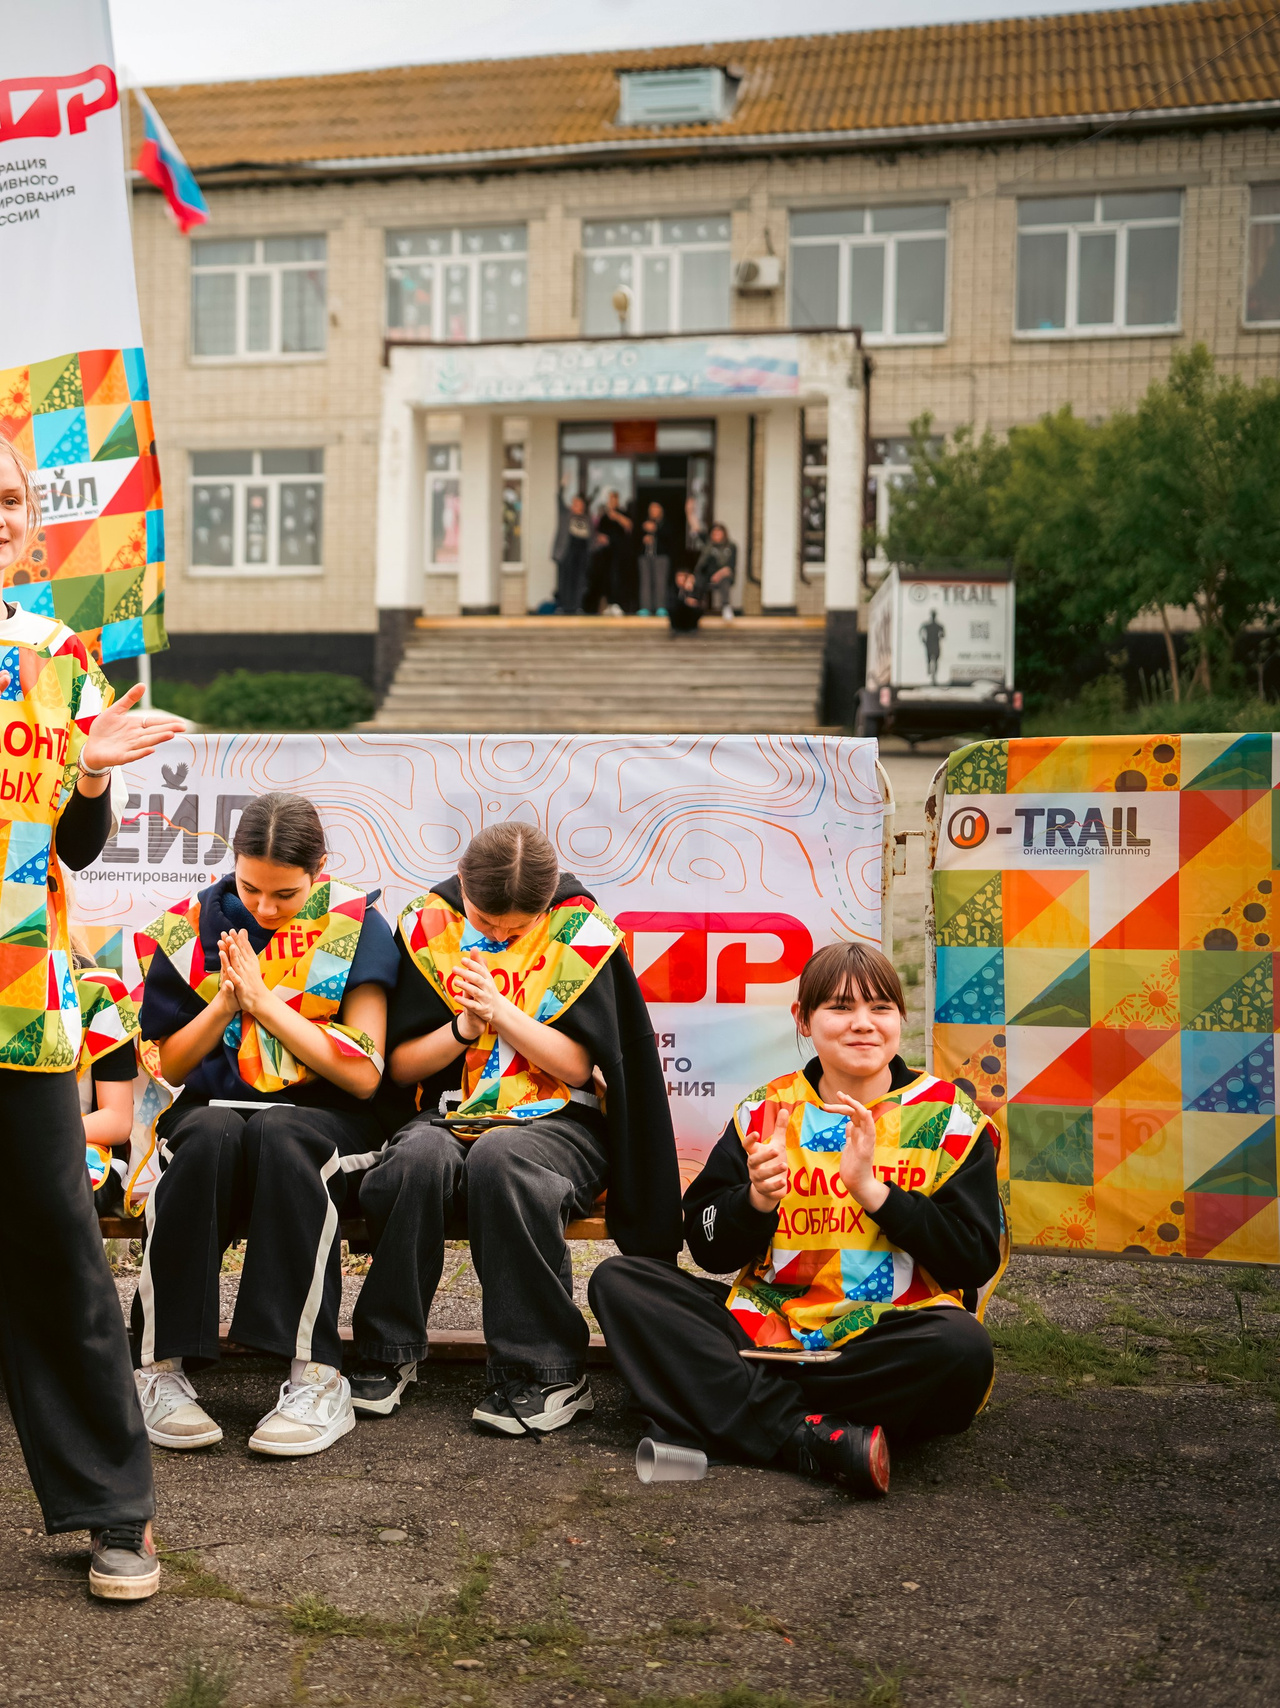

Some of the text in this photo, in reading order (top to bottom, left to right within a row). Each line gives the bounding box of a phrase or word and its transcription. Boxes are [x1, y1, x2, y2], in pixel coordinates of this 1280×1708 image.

[1023, 846, 1151, 857] orienteering&trailrunning
[80, 870, 207, 885] ориентирование
[775, 1206, 866, 1239] ДОБРЫХ
